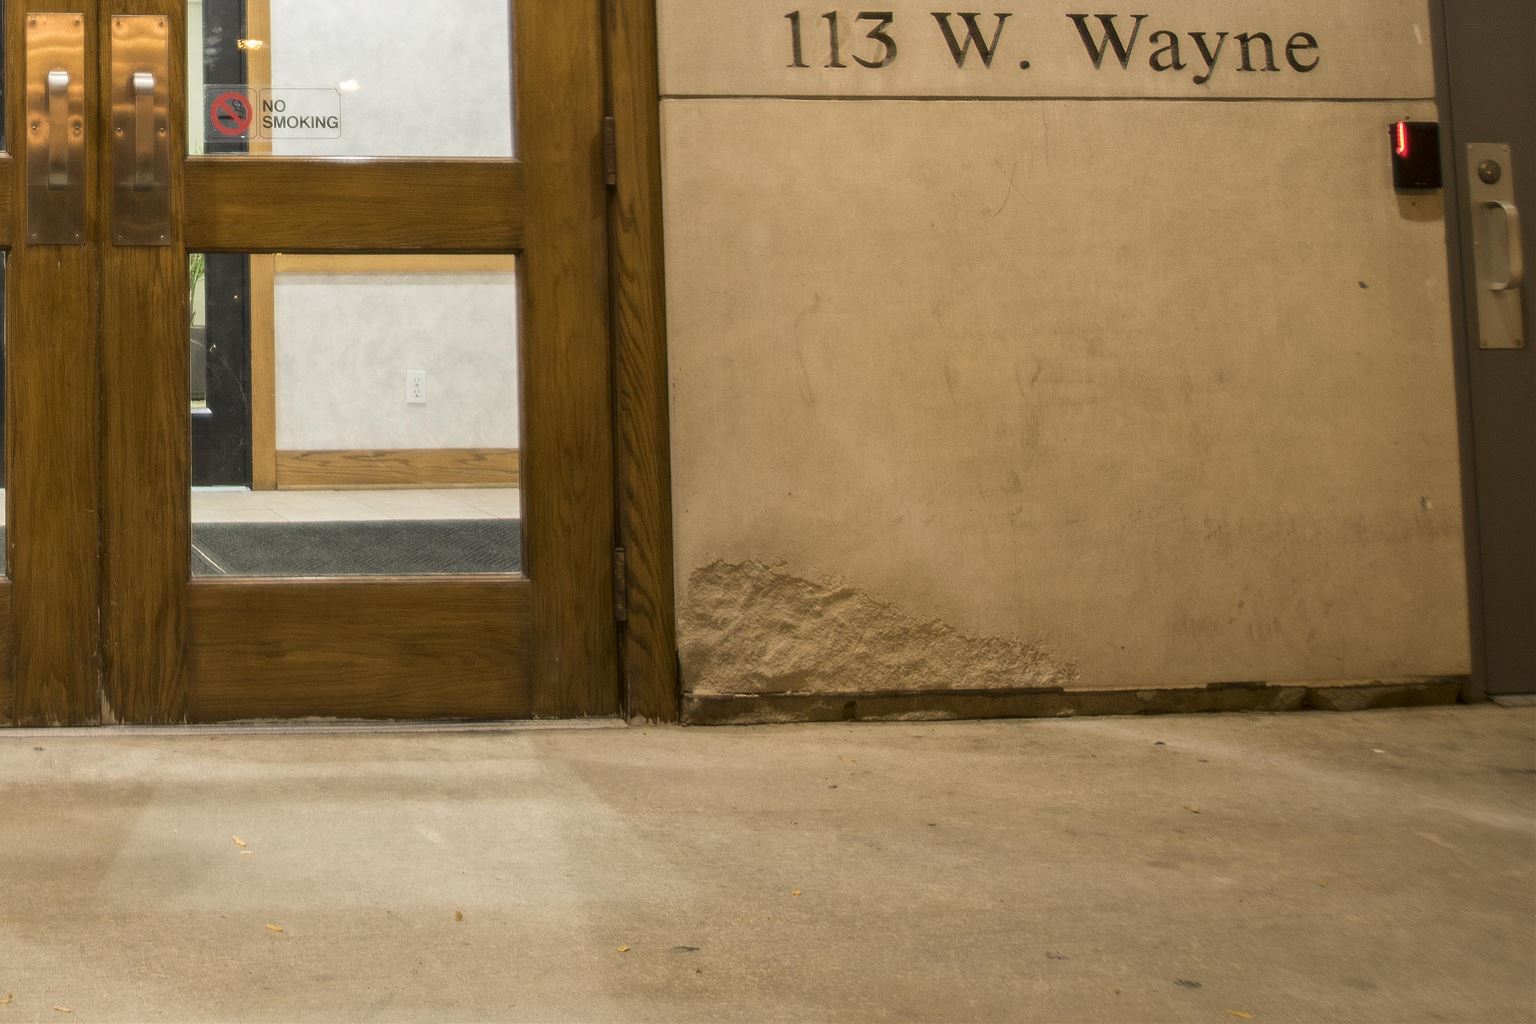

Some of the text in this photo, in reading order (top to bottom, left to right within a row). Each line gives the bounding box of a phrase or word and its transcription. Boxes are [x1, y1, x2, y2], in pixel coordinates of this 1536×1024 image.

[782, 9, 1321, 85] 113 W. Wayne
[262, 99, 286, 113] NO
[262, 115, 339, 129] SMOKING
